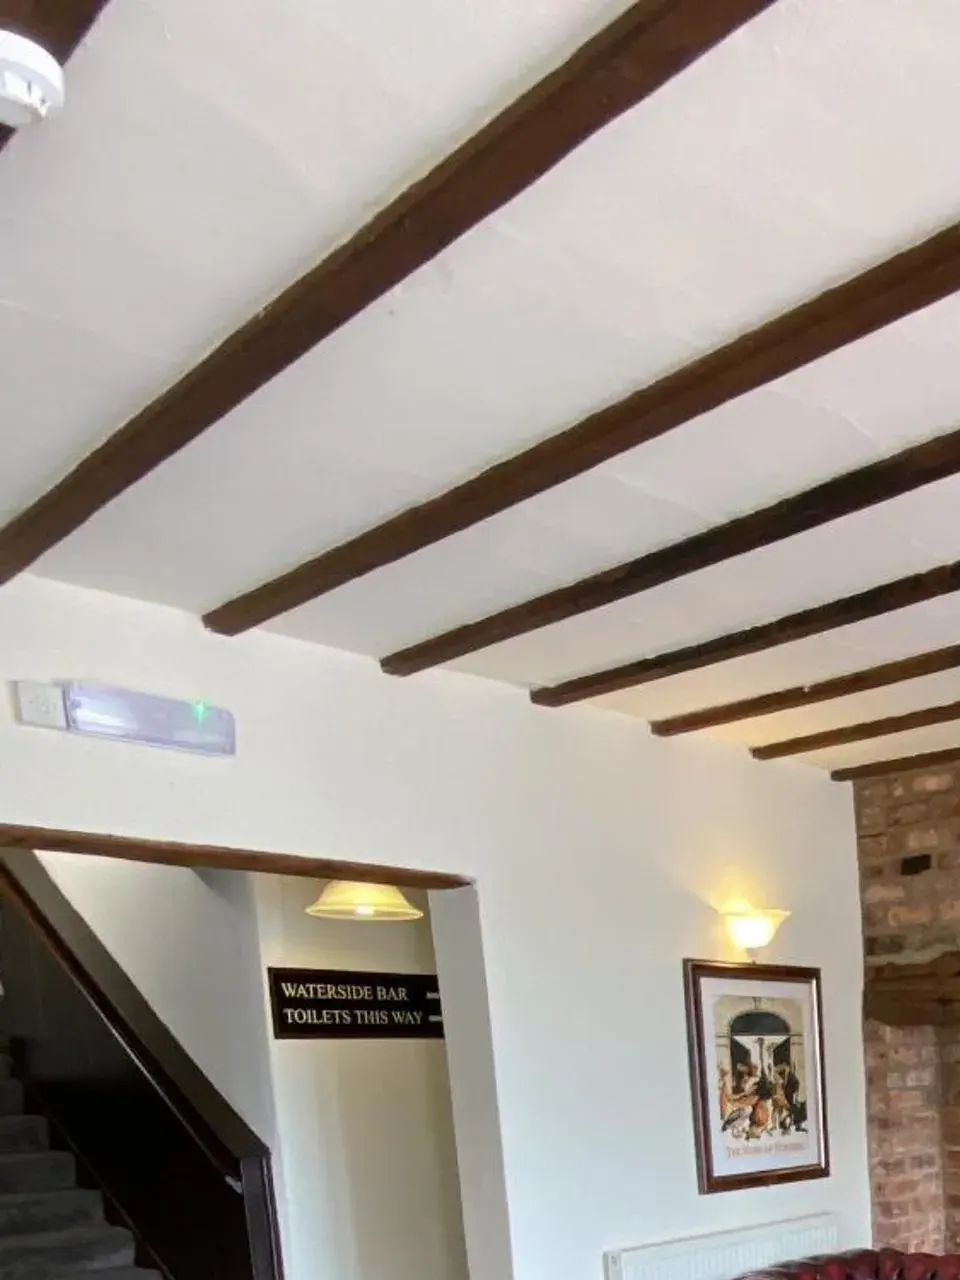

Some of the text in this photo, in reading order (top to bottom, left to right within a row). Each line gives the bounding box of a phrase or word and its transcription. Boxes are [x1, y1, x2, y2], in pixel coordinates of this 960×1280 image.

[280, 982, 408, 1001] WATERSIDE BAR
[283, 1008, 423, 1025] TOILETS THIS WAY
